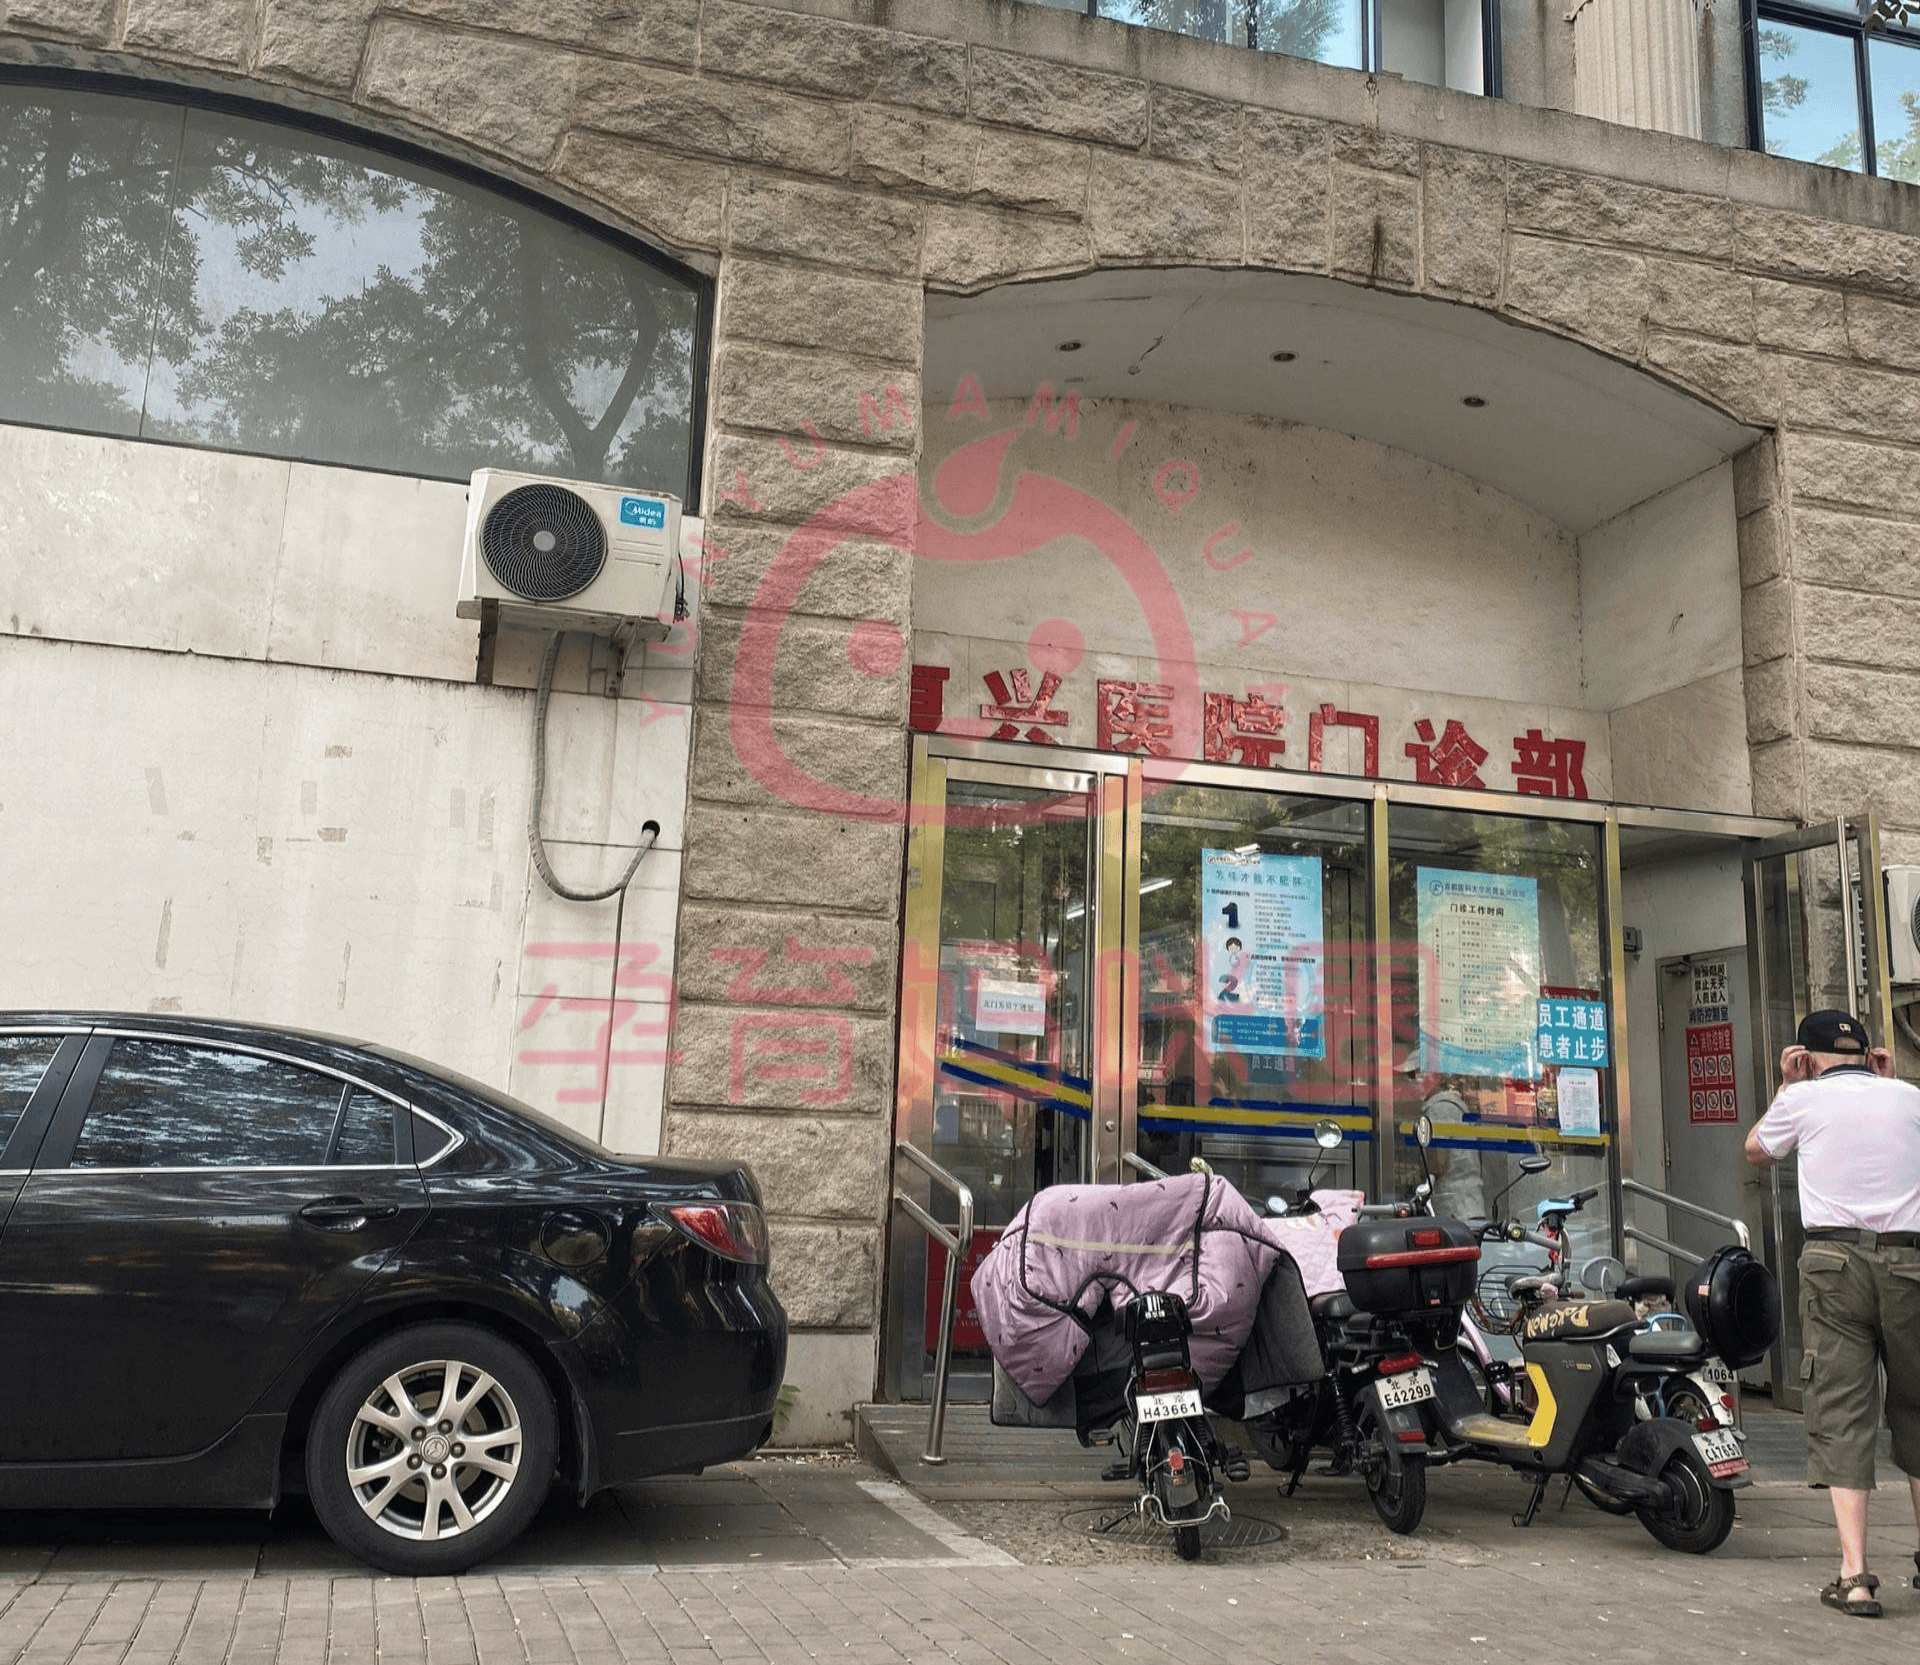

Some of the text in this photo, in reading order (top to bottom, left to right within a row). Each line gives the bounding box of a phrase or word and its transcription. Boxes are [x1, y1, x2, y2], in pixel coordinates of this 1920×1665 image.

[633, 506, 662, 518] Midea
[1221, 902, 1241, 929] 1
[1449, 903, 1505, 917] 门诊工作时间
[1217, 974, 1240, 1002] 2
[1538, 1003, 1605, 1032] 员工通道
[1538, 1033, 1606, 1061] 患者止步
[1384, 1383, 1431, 1407] E42299
[1143, 1401, 1198, 1420] H43661
